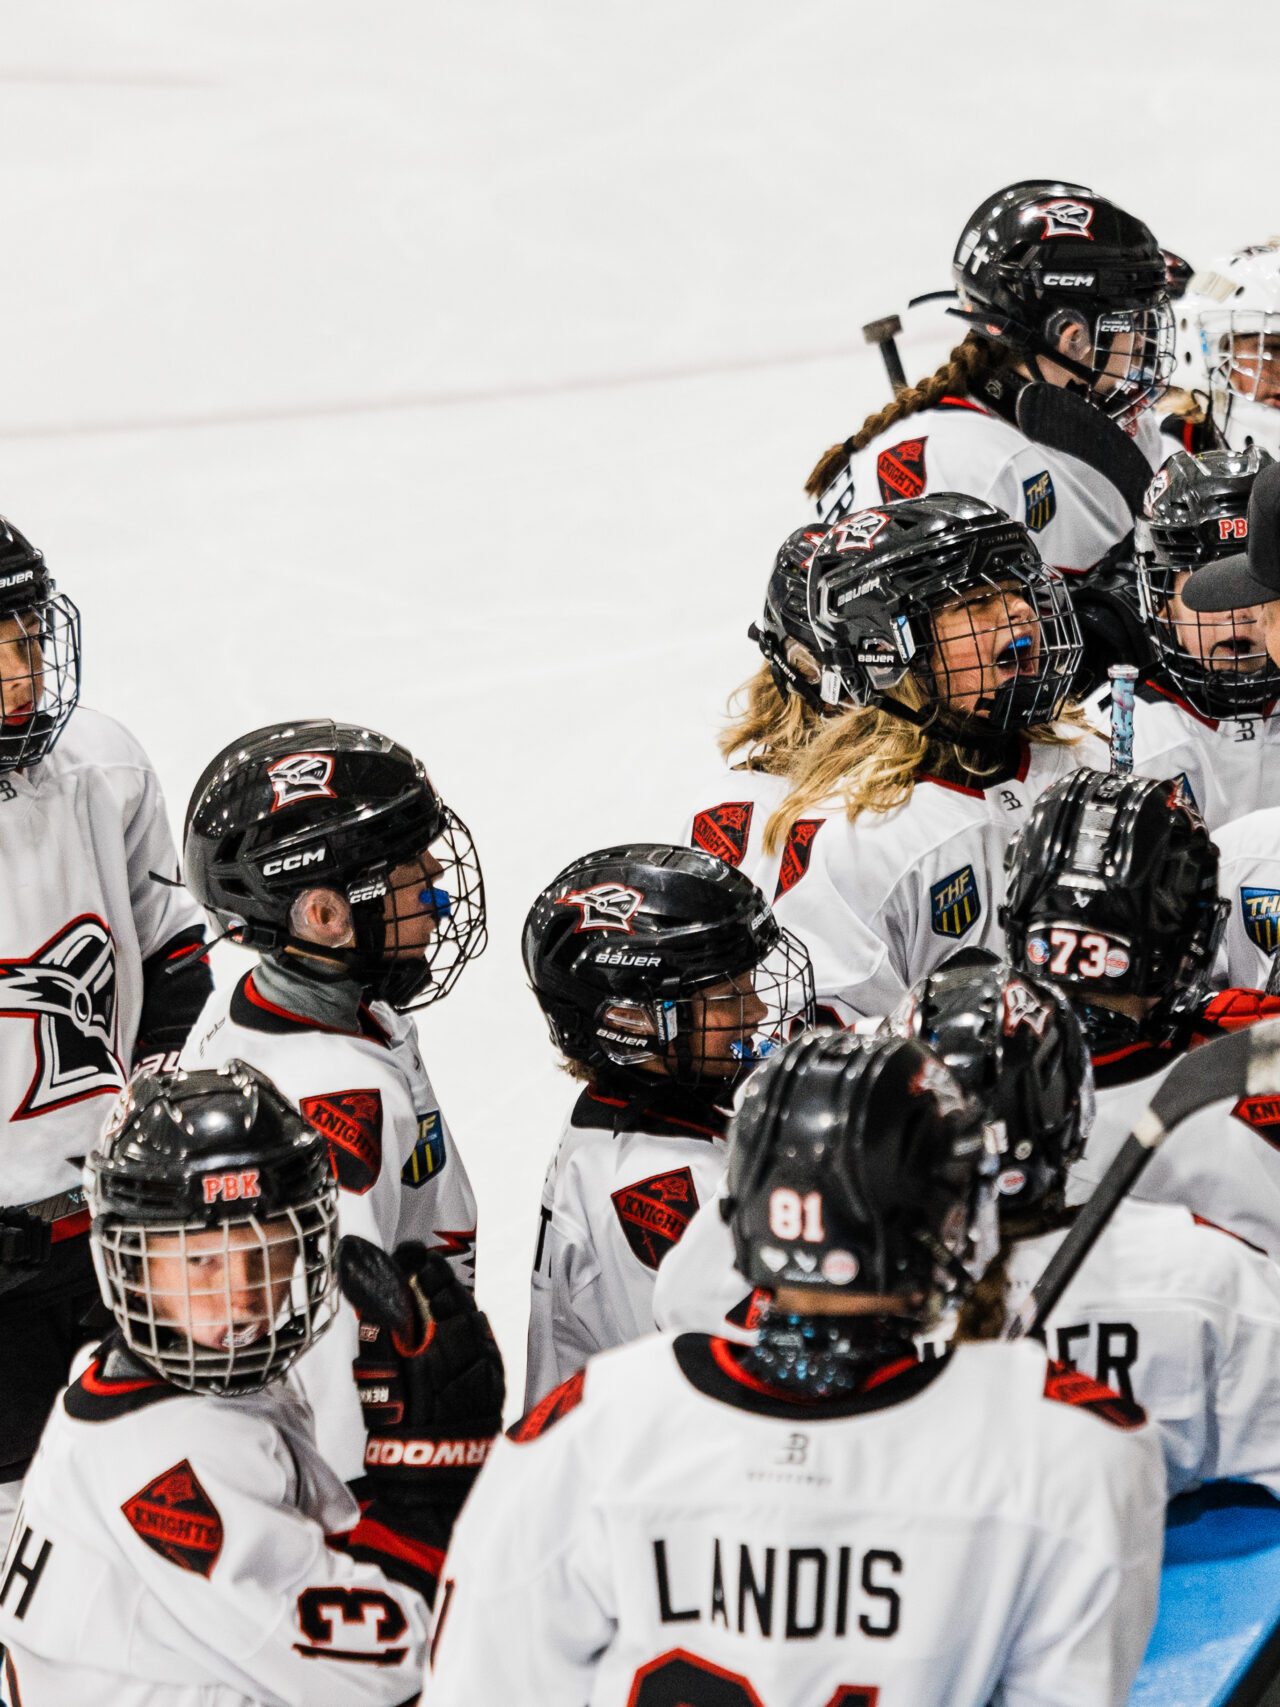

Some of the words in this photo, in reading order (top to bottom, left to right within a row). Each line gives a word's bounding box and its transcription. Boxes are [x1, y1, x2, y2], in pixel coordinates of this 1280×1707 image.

[1043, 274, 1095, 287] CCM
[1100, 324, 1131, 333] CCM
[880, 455, 922, 499] KNIGHTS
[1026, 472, 1050, 501] THF
[837, 576, 881, 607] BAUER
[858, 654, 894, 663] BAUER
[263, 848, 326, 877] CCM
[350, 886, 387, 904] CCM
[935, 869, 970, 910] THF
[595, 953, 662, 968] BAUER
[1050, 929, 1109, 978] 73
[596, 1028, 649, 1048] BAUER
[203, 1171, 260, 1202] PBK
[769, 1187, 824, 1242] 81
[364, 1438, 492, 1467] RWOOD
[652, 1537, 904, 1641] LANDIS
[292, 1586, 410, 1669] 13
